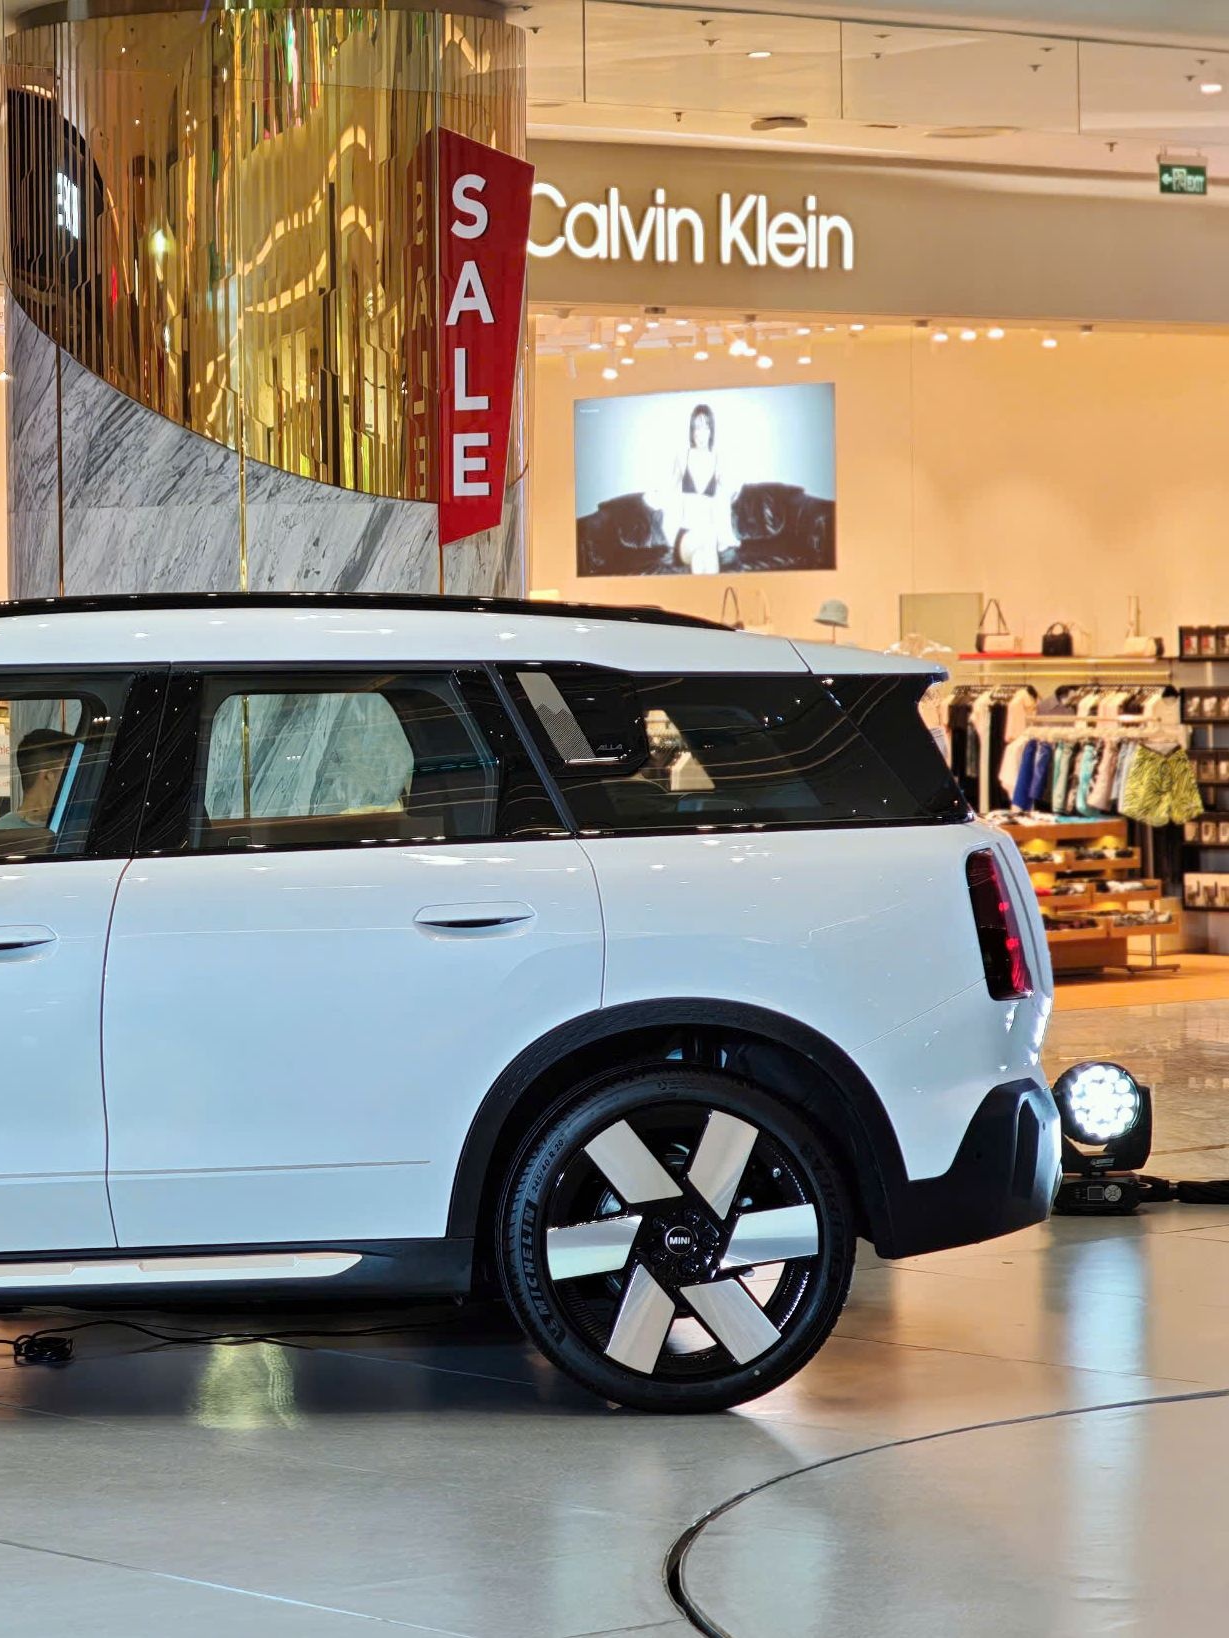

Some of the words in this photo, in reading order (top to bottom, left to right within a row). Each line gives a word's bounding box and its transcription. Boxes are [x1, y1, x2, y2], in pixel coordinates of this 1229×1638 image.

[527, 183, 704, 262] Calvin
[720, 193, 853, 270] Klein
[446, 174, 494, 496] SALE
[522, 1203, 551, 1317] MICHELIN
[669, 1236, 690, 1245] MINI
